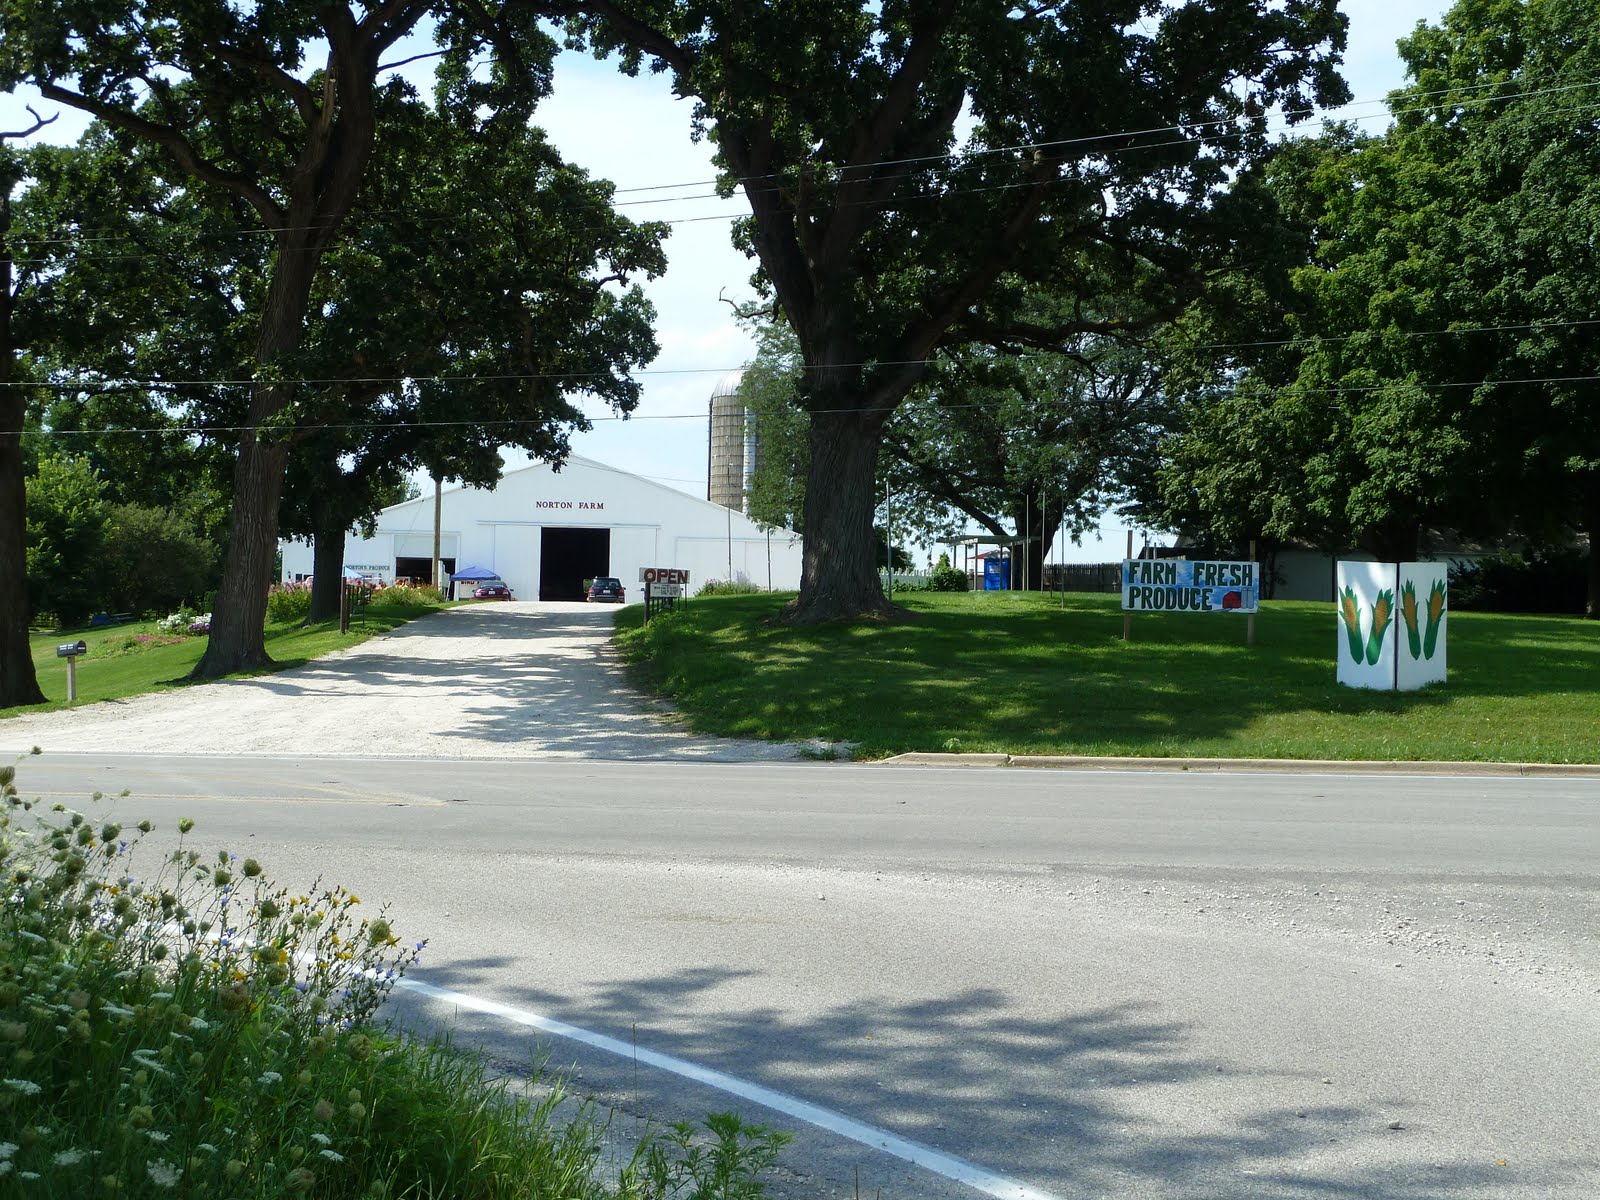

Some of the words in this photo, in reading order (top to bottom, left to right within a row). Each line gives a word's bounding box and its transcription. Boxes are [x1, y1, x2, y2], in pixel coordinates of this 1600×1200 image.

[536, 501, 573, 509] NORTON
[579, 502, 604, 510] FARM
[643, 568, 689, 584] OPEN
[1129, 562, 1177, 585] FARM
[1193, 562, 1253, 587] FRESH
[1128, 586, 1214, 611] PRODUCE
